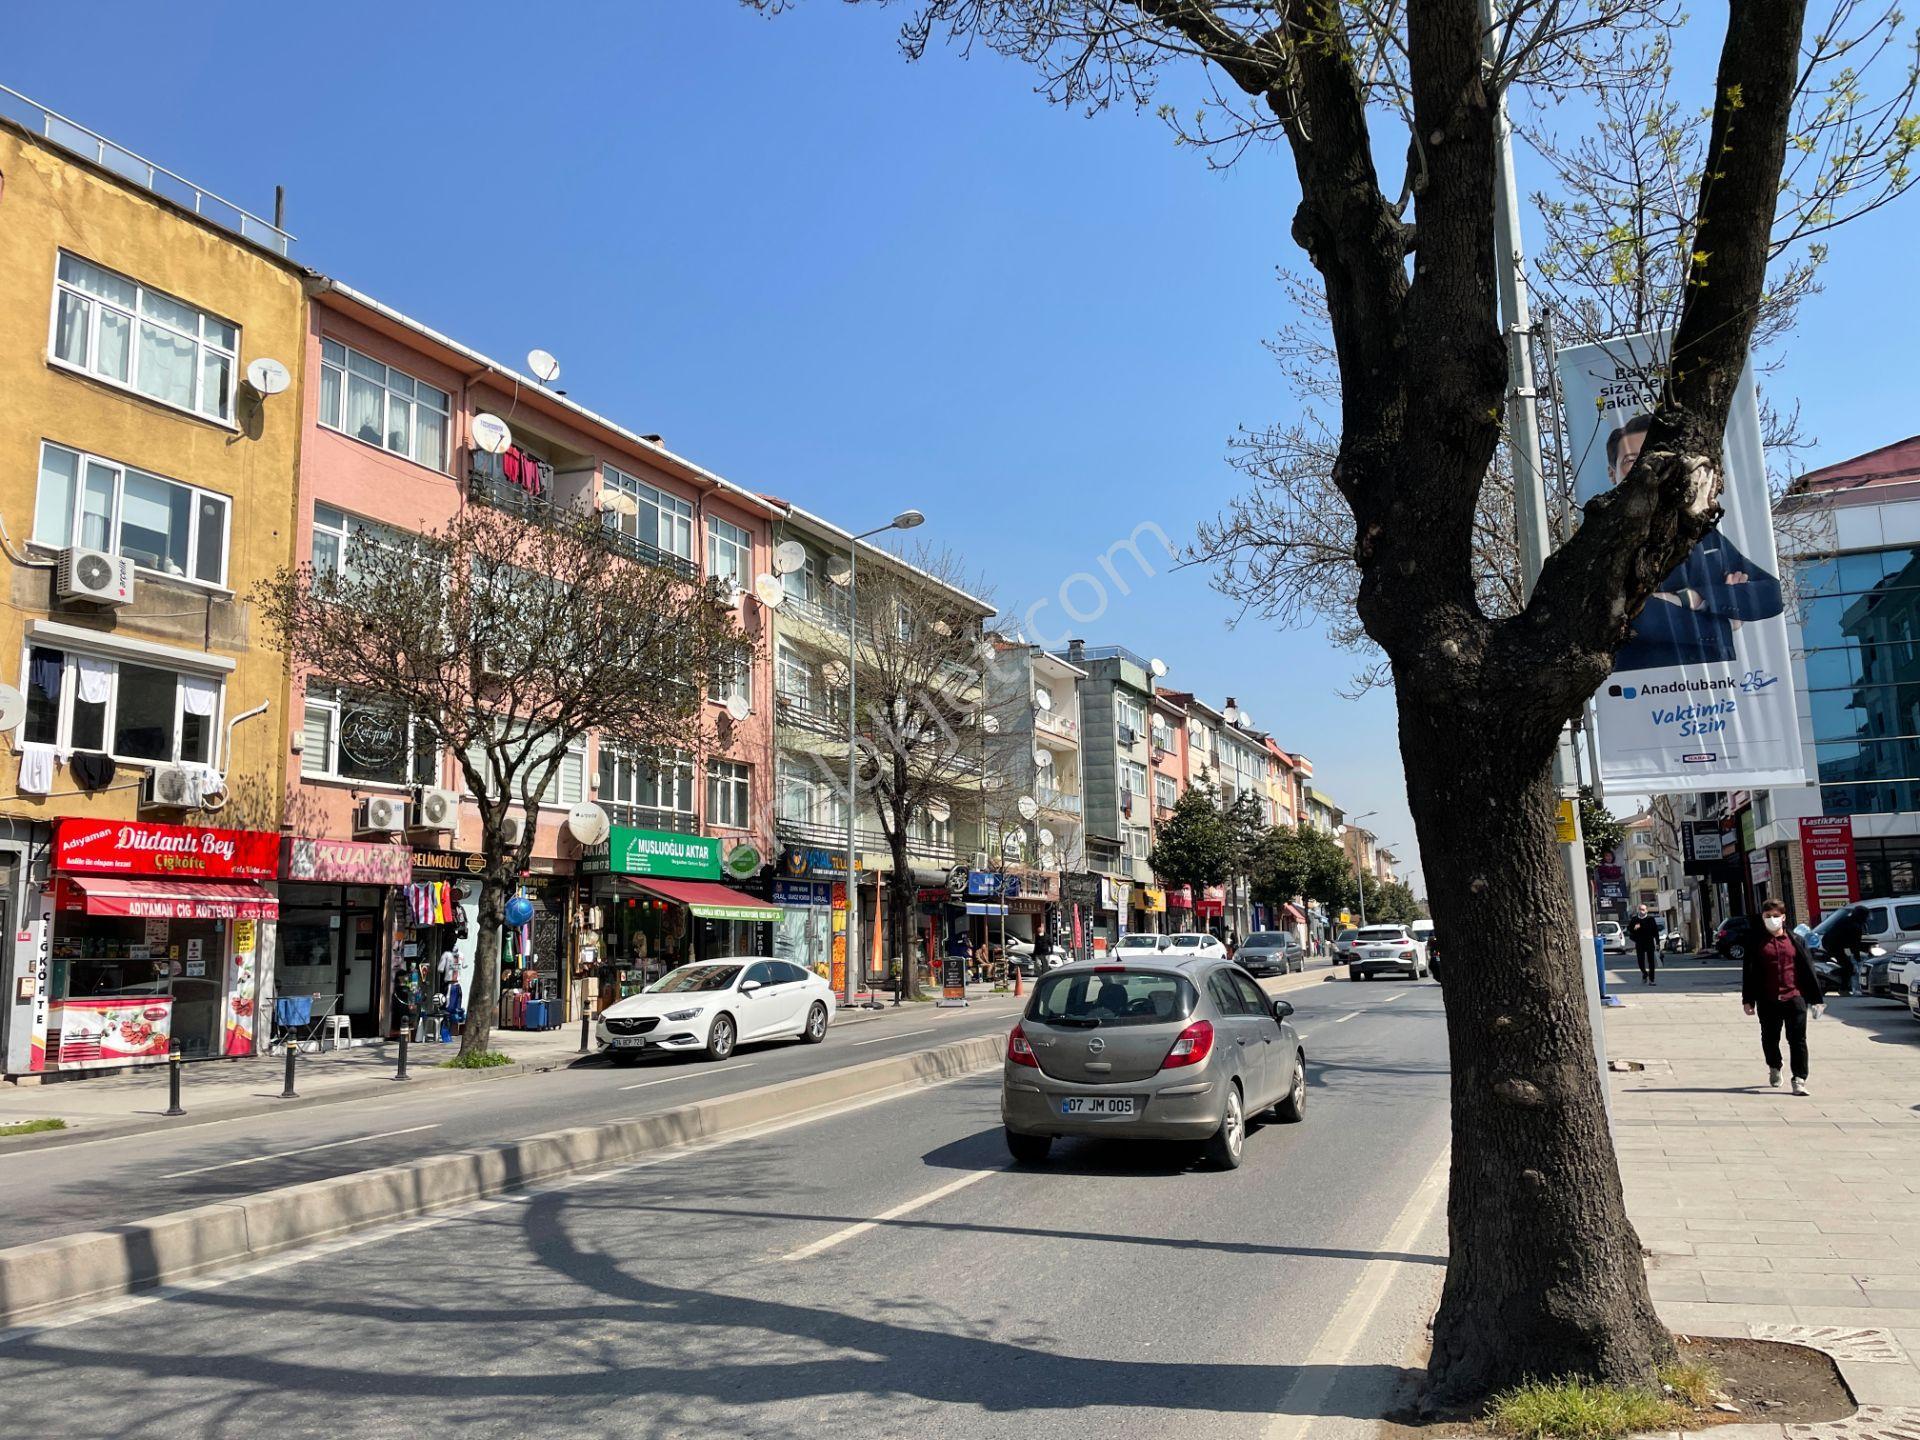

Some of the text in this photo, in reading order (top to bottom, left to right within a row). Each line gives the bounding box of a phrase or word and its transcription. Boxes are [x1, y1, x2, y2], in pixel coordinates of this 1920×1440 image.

[1600, 384, 1633, 397] size
[1640, 677, 1737, 696] Anadolubank
[1651, 699, 1737, 725] Vaktimiz
[1679, 720, 1726, 737] Sizin
[1802, 817, 1849, 826] LastikPark
[63, 829, 112, 851] Adıyaman
[201, 833, 235, 861] Bey
[639, 838, 685, 857] MUSLUOĞLU
[686, 844, 709, 859] AKTAR
[129, 902, 173, 916] ADIYAMAN
[1069, 1099, 1132, 1112] 07 JM 005
